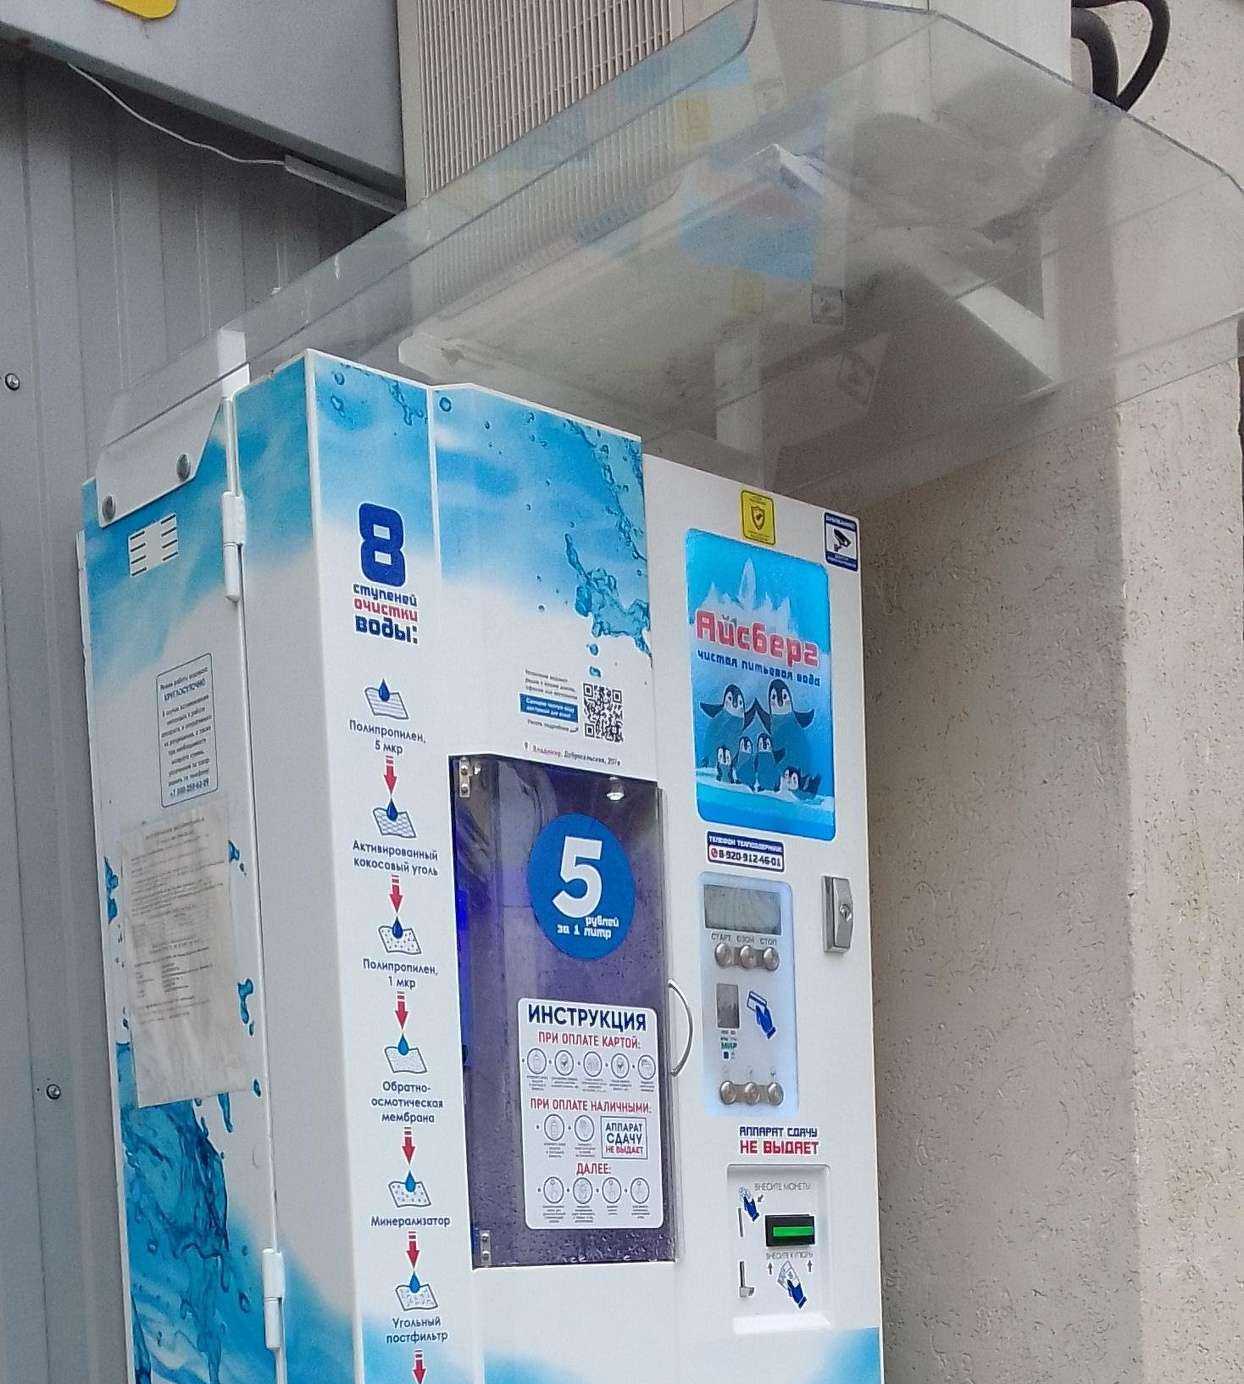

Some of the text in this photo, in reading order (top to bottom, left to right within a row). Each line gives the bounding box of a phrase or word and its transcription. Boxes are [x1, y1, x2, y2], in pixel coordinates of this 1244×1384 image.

[359, 503, 406, 587] 8
[353, 584, 417, 607] ступеней
[354, 598, 418, 621] очистки
[355, 615, 418, 643] воды:
[696, 610, 819, 667] Айсберг
[697, 650, 820, 686] чистая питьевая вода
[350, 720, 426, 743] Полипропилен,
[375, 740, 403, 755] 5 мкр
[353, 840, 438, 860] Активированный
[354, 858, 438, 876] кокосовый уголь
[552, 836, 602, 918] 5
[586, 915, 619, 928] рублей
[557, 925, 612, 940] за 1 литр
[363, 958, 438, 976] Полипропилен,
[396, 979, 416, 990] мкр
[528, 1004, 647, 1032] ИНСТРУКЦИЯ
[538, 1031, 641, 1049] ПРИ ОПЛАТЕ КАРТОЙ:
[382, 1081, 431, 1094] Обратно-
[371, 1098, 443, 1108] осмотическая
[530, 1098, 652, 1113] ПРИ ОПЛАТЕ НАЛИЧНЫМИ:
[382, 1112, 435, 1123] мембрана
[606, 1123, 643, 1132] АППАРАТ
[740, 1126, 818, 1138] АППАРАТ СДАЧУ
[606, 1133, 643, 1145] СДАЧУ
[605, 1145, 615, 1153] НЕ
[616, 1146, 644, 1154] ВЫДАЕТ
[740, 1140, 819, 1155] НЕ ВЫДАЕТ
[576, 1163, 611, 1175] ДАЛЕЕ:
[371, 1216, 451, 1227] Минерализатор
[392, 1317, 441, 1329] Угольный
[386, 1331, 448, 1343] постфильтр
